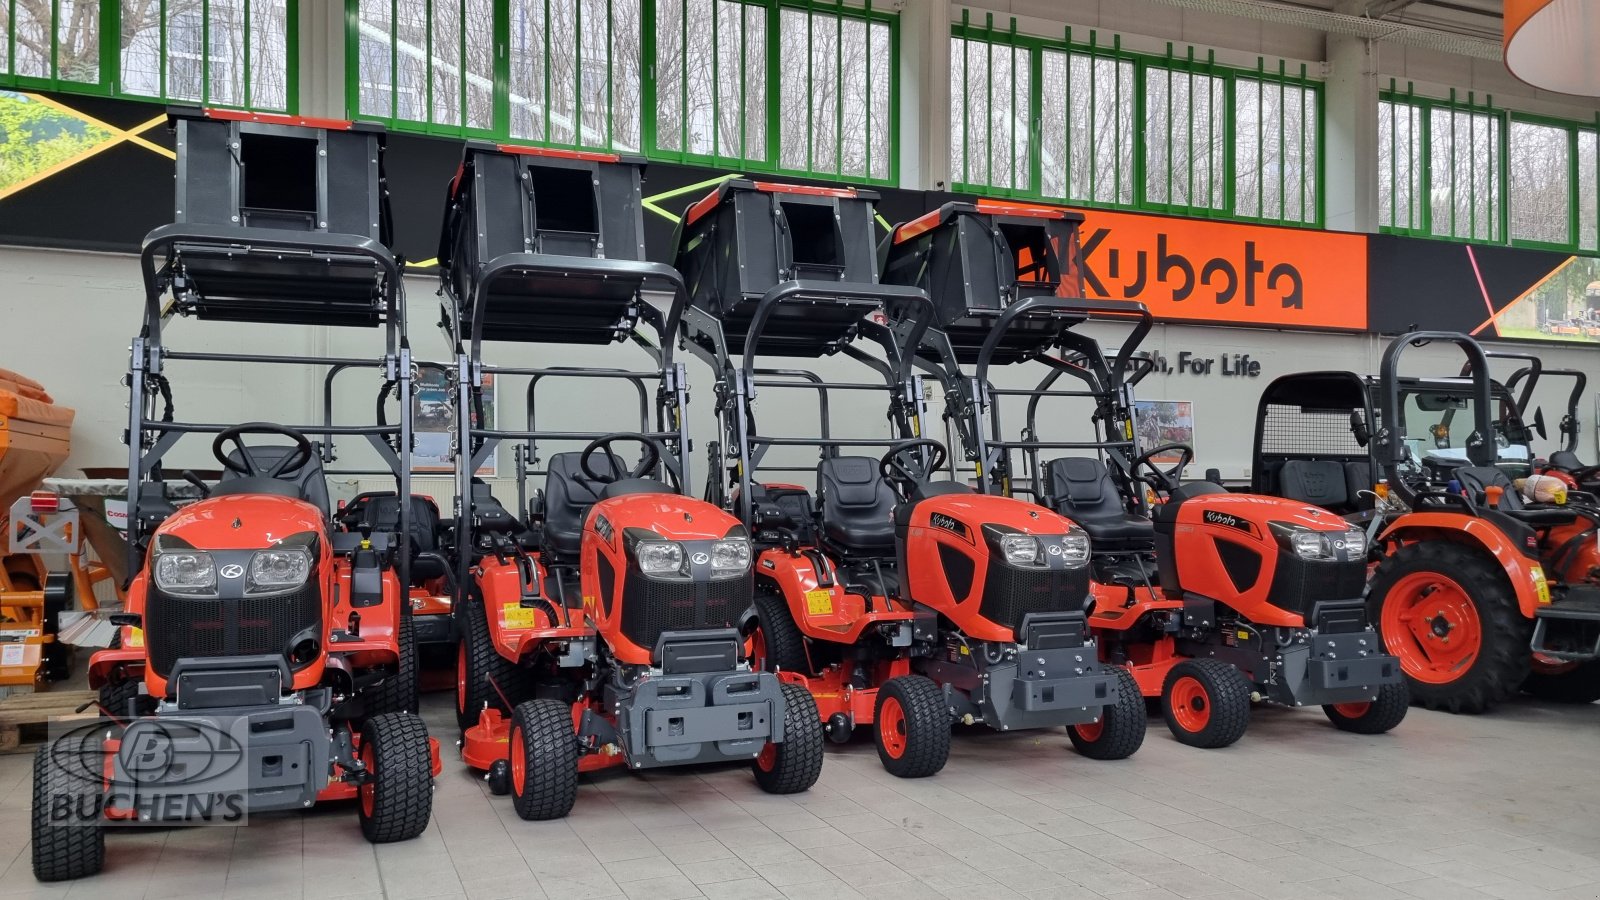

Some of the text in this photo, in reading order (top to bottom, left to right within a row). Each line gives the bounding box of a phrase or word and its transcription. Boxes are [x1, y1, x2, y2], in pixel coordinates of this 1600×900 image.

[1058, 228, 1303, 309] Kubota
[1179, 351, 1214, 375] For
[1222, 353, 1261, 376] Life
[933, 514, 955, 530] Kubota
[1206, 511, 1236, 526] Kubota
